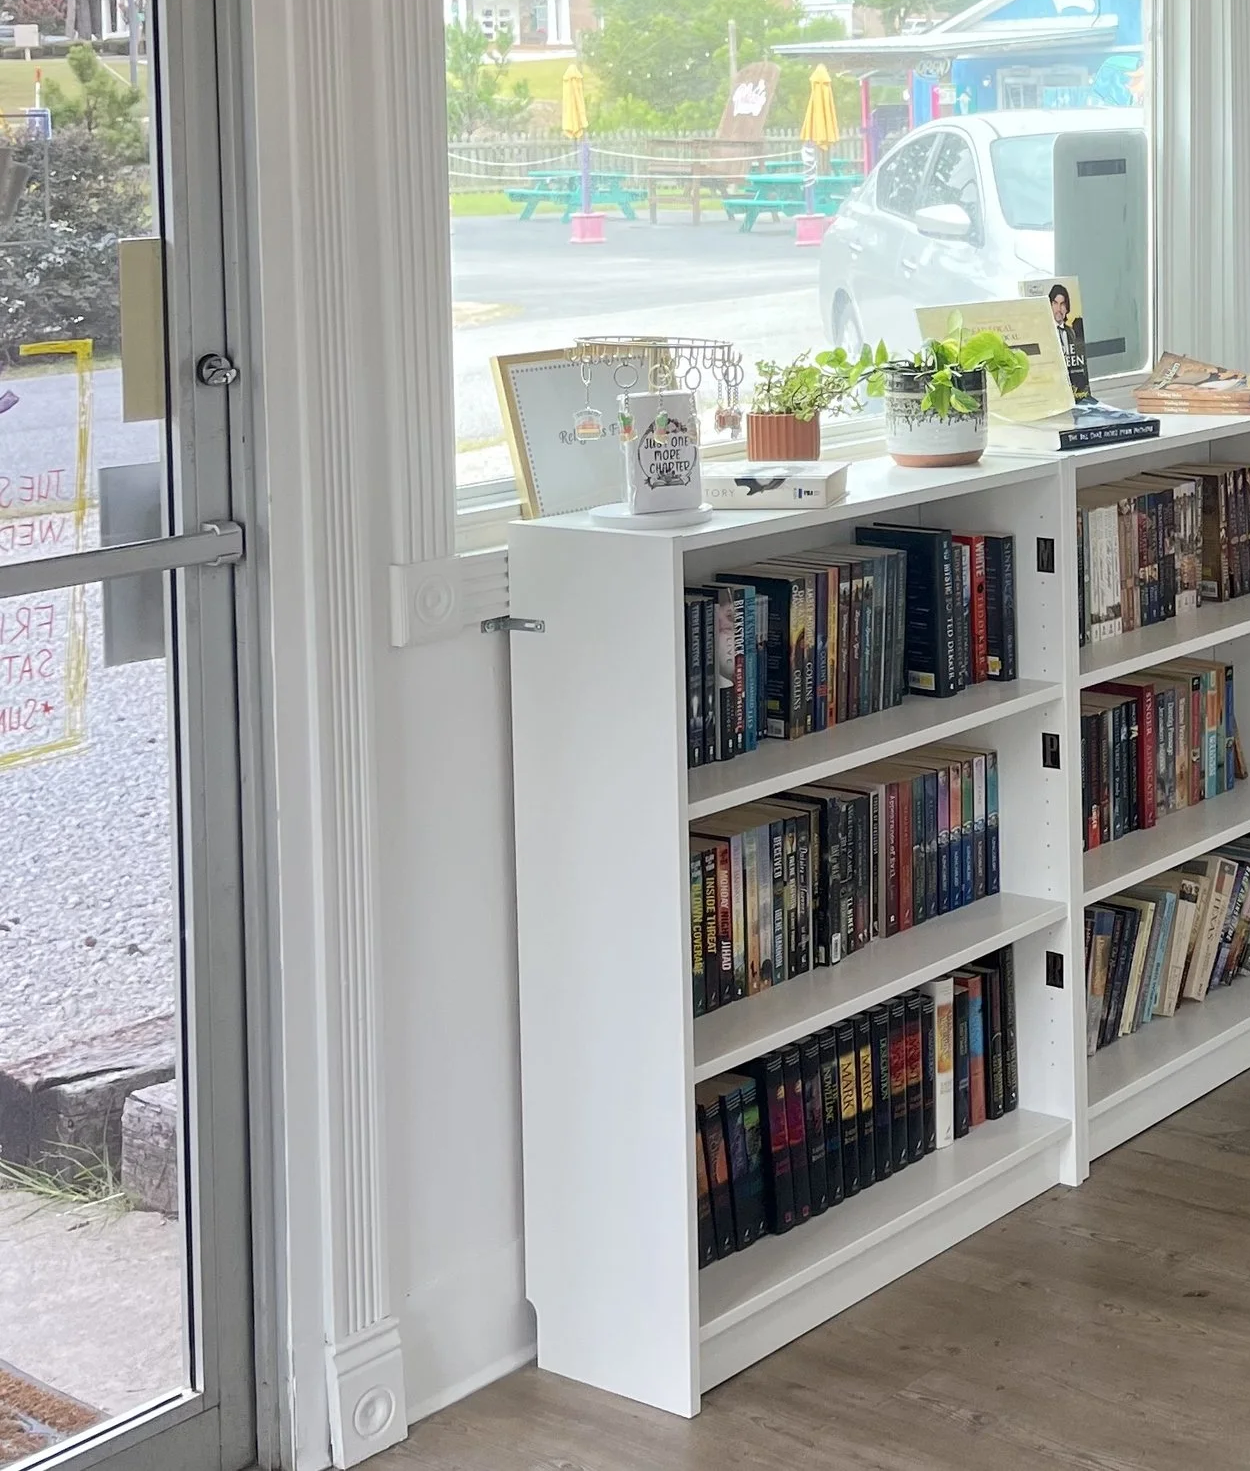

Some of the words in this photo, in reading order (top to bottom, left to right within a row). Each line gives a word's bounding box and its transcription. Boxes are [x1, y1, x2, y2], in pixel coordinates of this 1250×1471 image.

[653, 448, 682, 462] MORE
[670, 435, 690, 449] ONE
[649, 459, 691, 476] CHAPTER
[703, 487, 736, 498] TORY
[975, 541, 986, 578] WHITE
[733, 599, 745, 656] BLACKSTOCK
[946, 616, 954, 639] TED
[947, 640, 956, 680] DEKKER
[793, 669, 802, 711] COLLINS
[805, 661, 814, 702] COLLINS
[1145, 691, 1153, 737] SINGER
[1045, 734, 1060, 768] P
[772, 835, 783, 880] DECEIVED
[691, 883, 703, 923] BLOWN
[705, 876, 717, 914] INSIDE
[706, 914, 718, 955] THREAT
[774, 908, 785, 932] IRENE
[1207, 895, 1222, 942] TEXAS
[720, 940, 732, 971] JIHAD
[774, 931, 786, 969] HANNON
[840, 1062, 856, 1112] MARK
[861, 1054, 873, 1103] MARK
